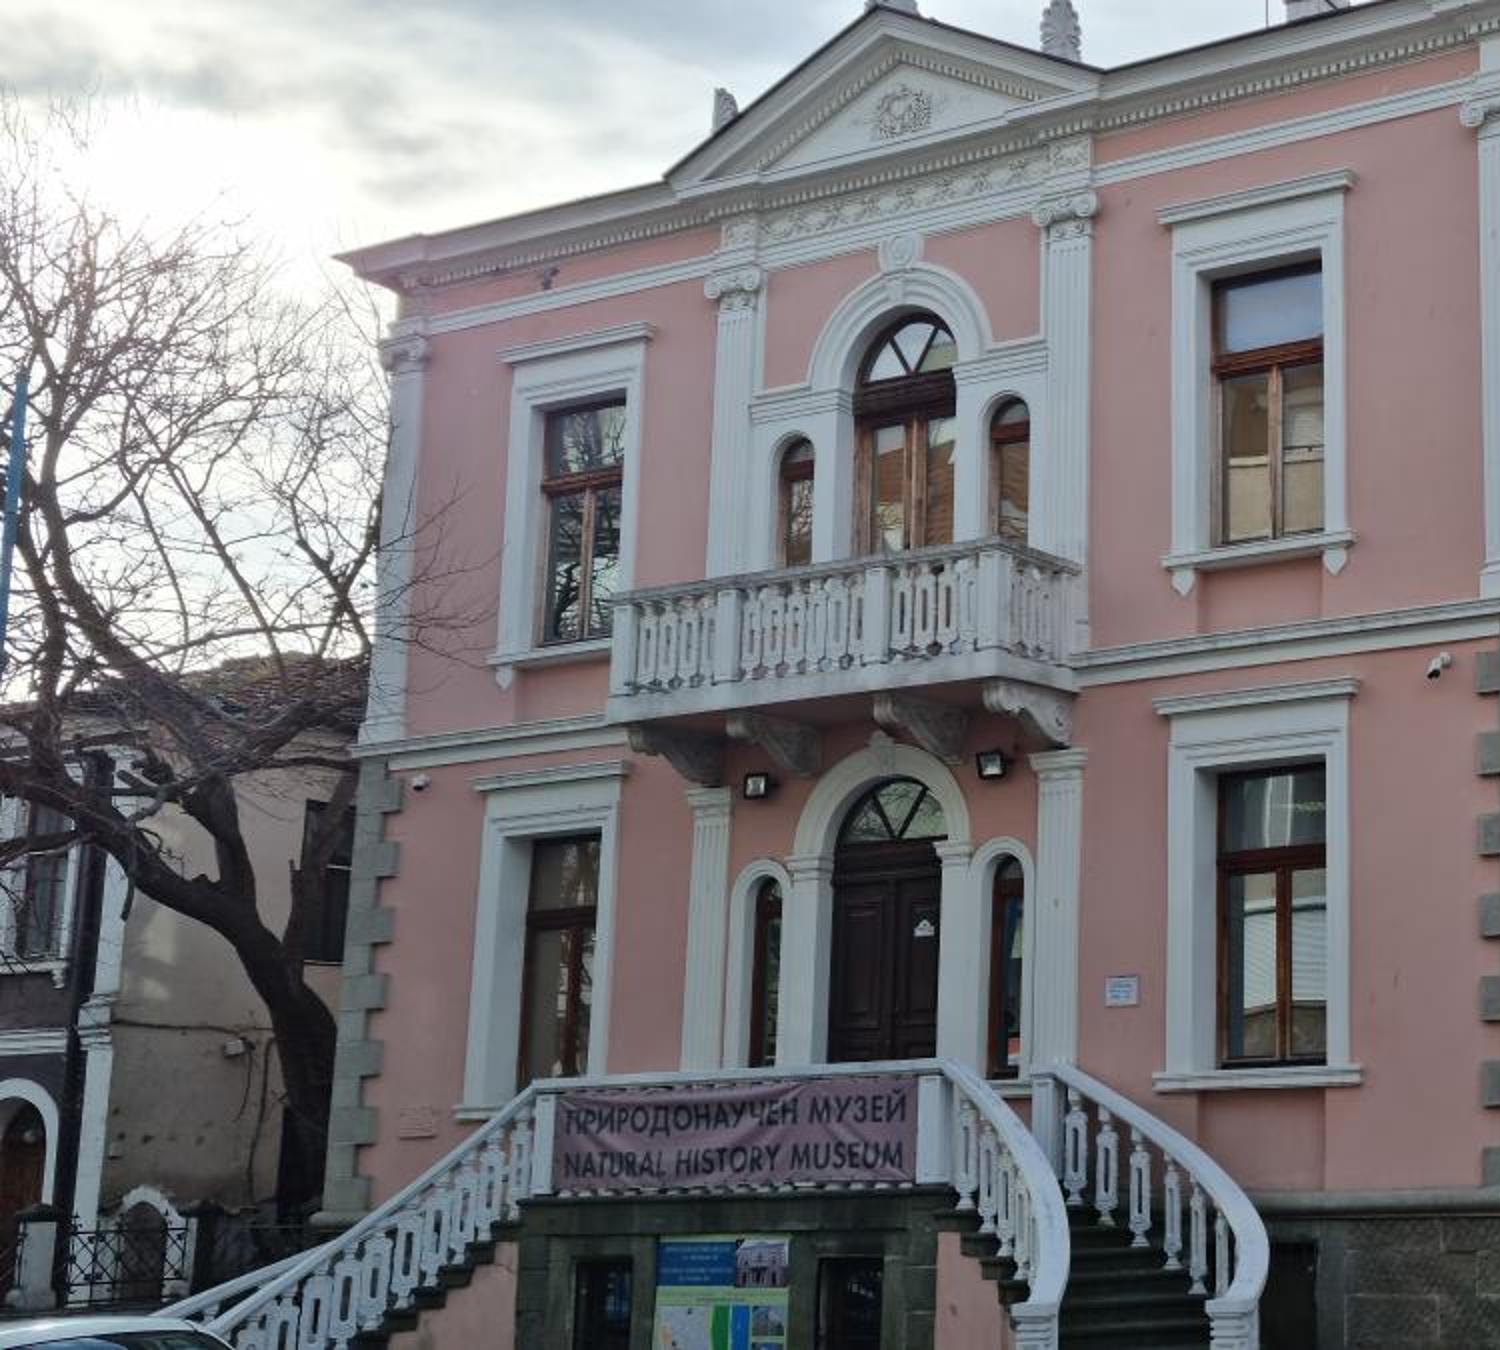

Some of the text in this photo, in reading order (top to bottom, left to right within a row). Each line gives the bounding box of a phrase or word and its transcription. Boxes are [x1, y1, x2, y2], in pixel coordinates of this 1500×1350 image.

[565, 1088, 907, 1137] ПРИРОДОНАУЧЕН МУЗЕЙ
[564, 1141, 903, 1177] NATURAL HISTORY MUSEUM
